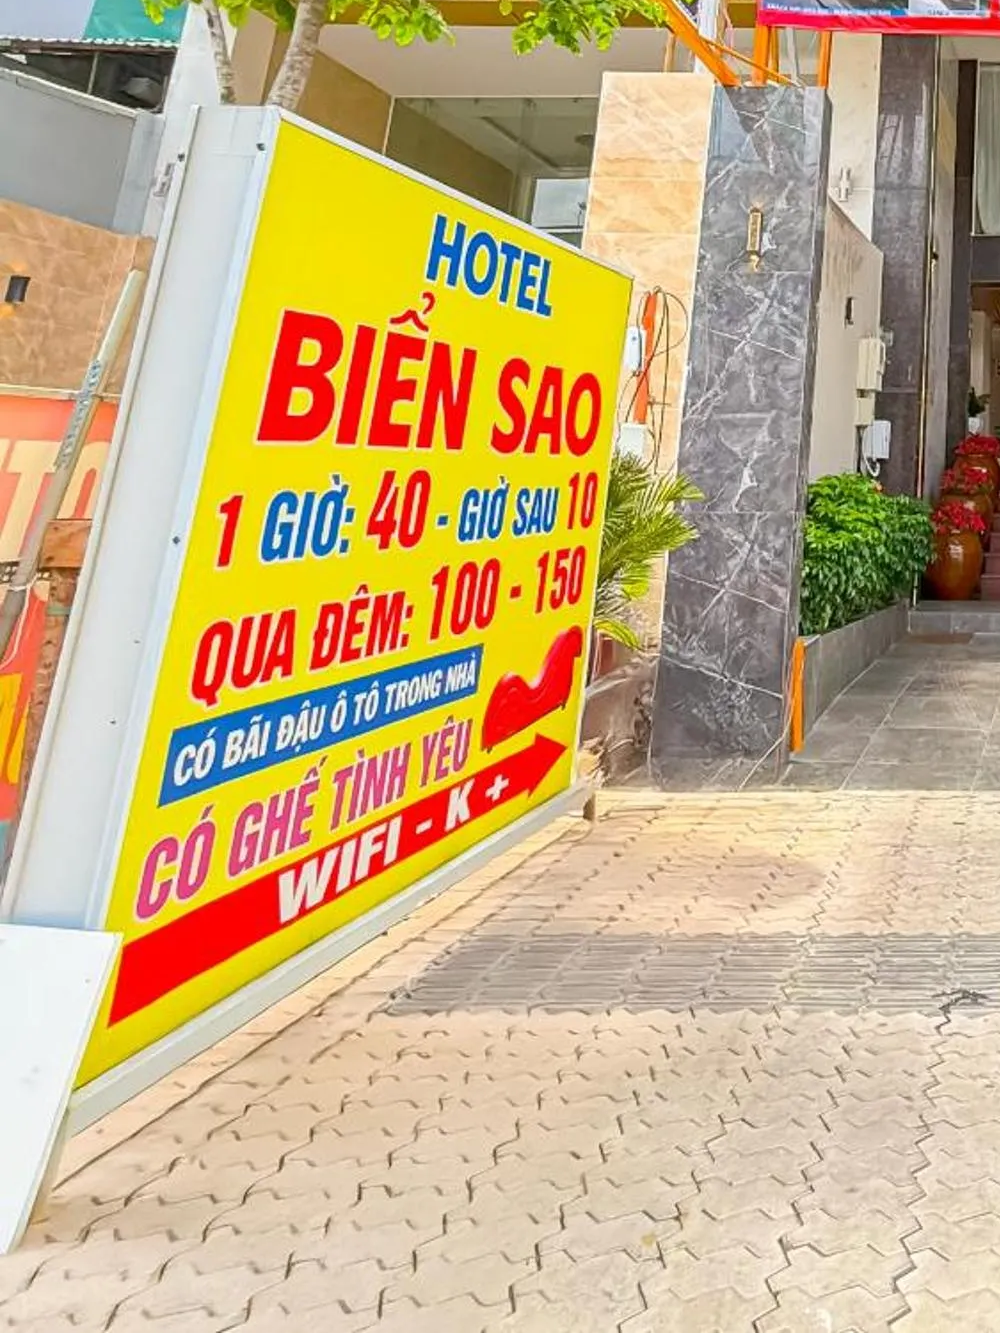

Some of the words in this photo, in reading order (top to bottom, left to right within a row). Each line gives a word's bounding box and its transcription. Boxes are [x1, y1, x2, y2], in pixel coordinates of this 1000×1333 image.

[426, 213, 552, 317] HOTEL
[257, 291, 477, 450] BIỂN
[491, 357, 601, 456] SAO
[217, 495, 243, 567] 1
[261, 474, 355, 563] GIỜ:
[366, 470, 431, 550] 40
[457, 476, 509, 543] GIỜ
[512, 486, 560, 537] SAU
[567, 472, 598, 530] 10
[192, 608, 296, 706] QUA
[310, 584, 414, 670] ĐÊM:
[430, 558, 500, 641] 100
[535, 545, 587, 614] 150
[173, 727, 216, 787] CÓ
[222, 713, 271, 770] BÃI
[275, 700, 327, 753] ĐẬU
[330, 690, 348, 733] Ô
[353, 682, 381, 726] TÔ
[385, 669, 442, 714] TRONG
[445, 654, 477, 695] NHÀ
[135, 801, 217, 921] CÓ
[228, 754, 327, 879] GHẾ
[332, 742, 411, 834] TÌNH
[420, 714, 473, 788] YÊU
[277, 815, 402, 925] WIFI
[444, 774, 477, 833] K
